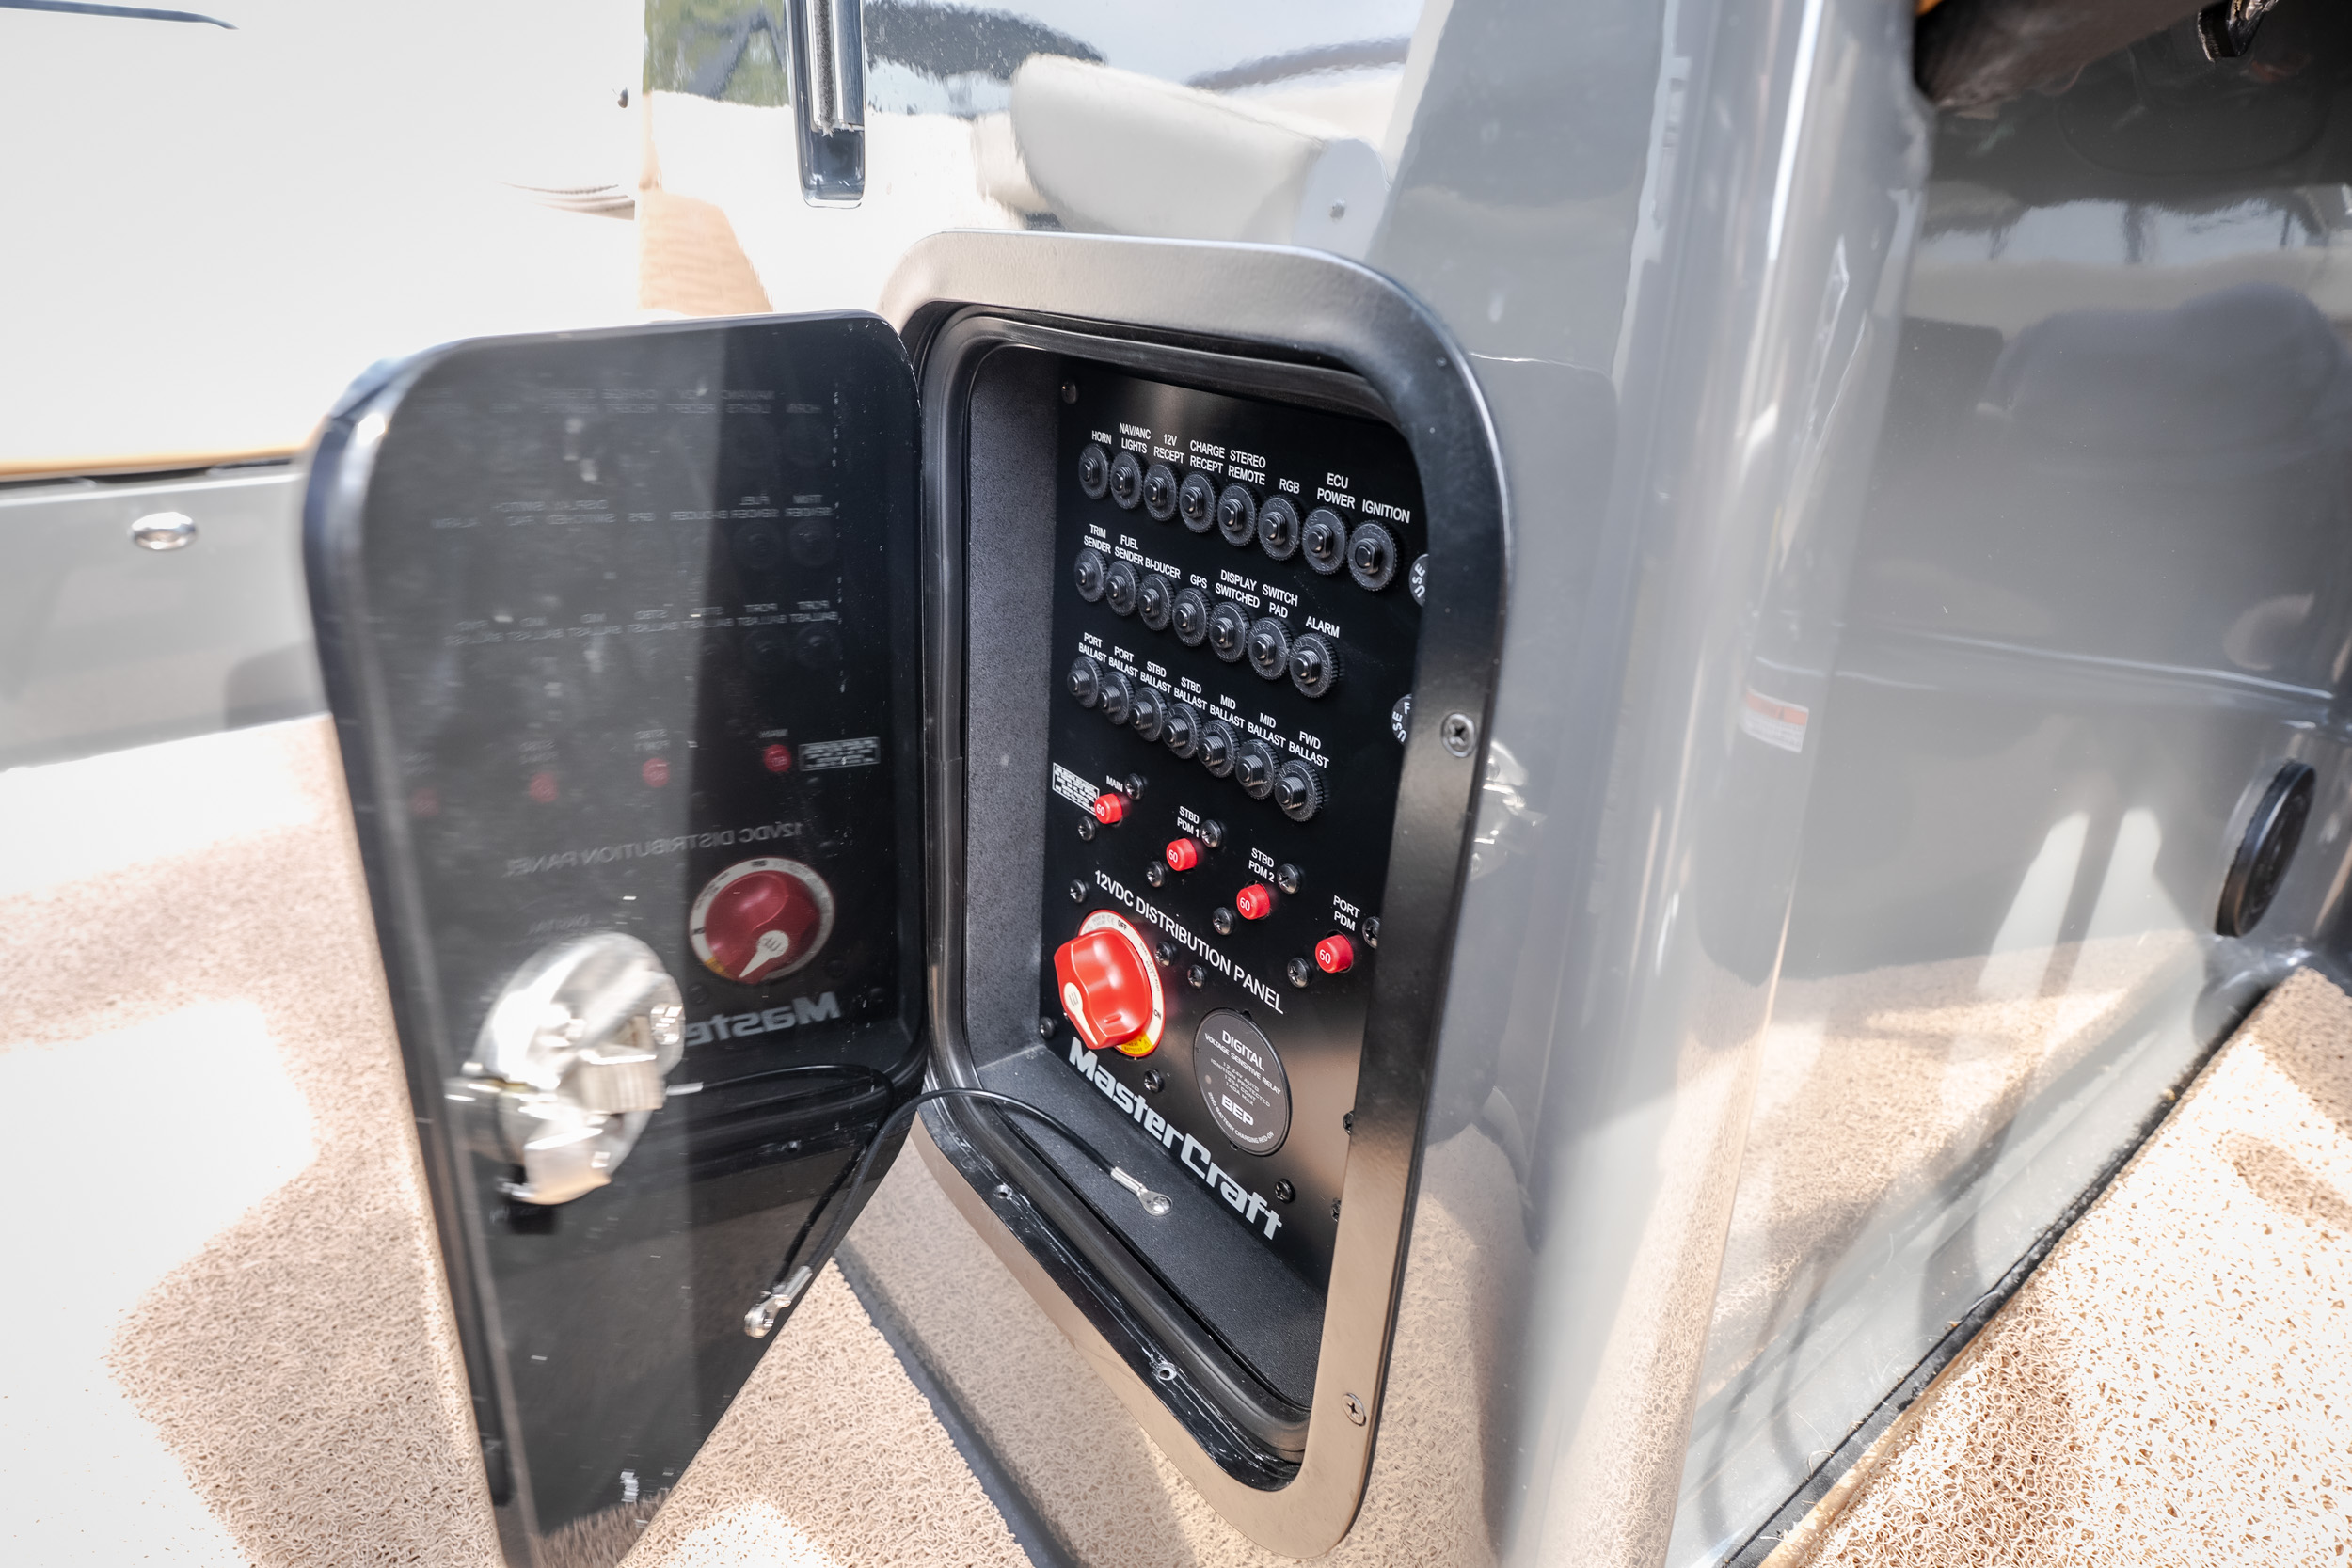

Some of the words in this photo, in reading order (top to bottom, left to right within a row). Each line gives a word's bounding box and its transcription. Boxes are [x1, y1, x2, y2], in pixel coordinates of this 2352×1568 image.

[1091, 430, 1112, 445] HORN
[1119, 422, 1152, 440] NAV/ANC
[1163, 433, 1178, 447] 12V
[1120, 437, 1148, 454] LIGHTS
[1153, 446, 1185, 464] RECEPT
[1189, 439, 1225, 459] CHARGE
[1189, 454, 1224, 474] RECEPT
[1229, 449, 1266, 469] STEREO
[1228, 465, 1266, 485] REMOTE
[1327, 472, 1349, 489] ECU
[1279, 478, 1300, 495] RGB
[1316, 487, 1356, 510] POWER
[1361, 499, 1410, 524] IGNITION
[1089, 523, 1106, 539] TRIM
[1083, 535, 1112, 554] SENDER
[1120, 534, 1139, 550] FUEL
[1114, 546, 1144, 566] SENDER
[1145, 557, 1182, 580] BI-DUCER
[1190, 574, 1208, 590] GPS
[1220, 569, 1258, 592] DISPLAY
[1215, 582, 1261, 609] SWITCHED
[1262, 583, 1299, 607] SWITCH
[1268, 602, 1289, 619] PAD
[1305, 615, 1341, 639] ALARM
[1083, 631, 1103, 649] PORT
[1078, 642, 1107, 663] BALLAST
[1114, 645, 1135, 663] PORT
[1108, 656, 1139, 678] BALLAST
[1146, 661, 1168, 678] STBD
[1139, 671, 1172, 694] BALLAST
[1181, 676, 1202, 694] STBD
[1173, 687, 1208, 711] BALLAST
[1220, 694, 1236, 711] MID
[1209, 705, 1246, 729] BALLAST
[1259, 712, 1277, 729] MID
[1248, 721, 1287, 748] BALLAST
[1299, 730, 1322, 750] FWD
[1288, 741, 1330, 769] BALLAST
[1105, 775, 1123, 793] MAIN
[1096, 803, 1105, 816] 60
[1179, 805, 1200, 825] STBD
[1177, 816, 1194, 835] PDM
[1195, 828, 1200, 838] 1
[1168, 848, 1179, 863] 60
[1250, 847, 1275, 868] STBD
[1248, 859, 1267, 879] PDM
[1268, 872, 1275, 883] 2
[1240, 896, 1251, 911] 60
[1332, 895, 1361, 919] PORT
[1117, 919, 1127, 931] OFF
[1333, 910, 1356, 932] PDM
[1094, 869, 1134, 907] 12VDC
[1136, 896, 1232, 977] DISTRIBUTION
[1232, 964, 1284, 1016] PANEL
[1319, 949, 1331, 965] 60
[1222, 1029, 1265, 1071] DIGITAL
[1204, 1032, 1230, 1056] VOLTAGE
[1230, 1052, 1262, 1080] SENSITIVE
[1262, 1075, 1281, 1096] RELAY
[1210, 1058, 1236, 1080] IGNITION
[1237, 1078, 1270, 1107] PROTECTED
[1244, 1076, 1260, 1093] AUTO
[1240, 1085, 1257, 1101] CONT
[1216, 1106, 1235, 1132] BATTERY
[1221, 1094, 1254, 1126] BEP
[1069, 1036, 1283, 1241] MasterCraft
